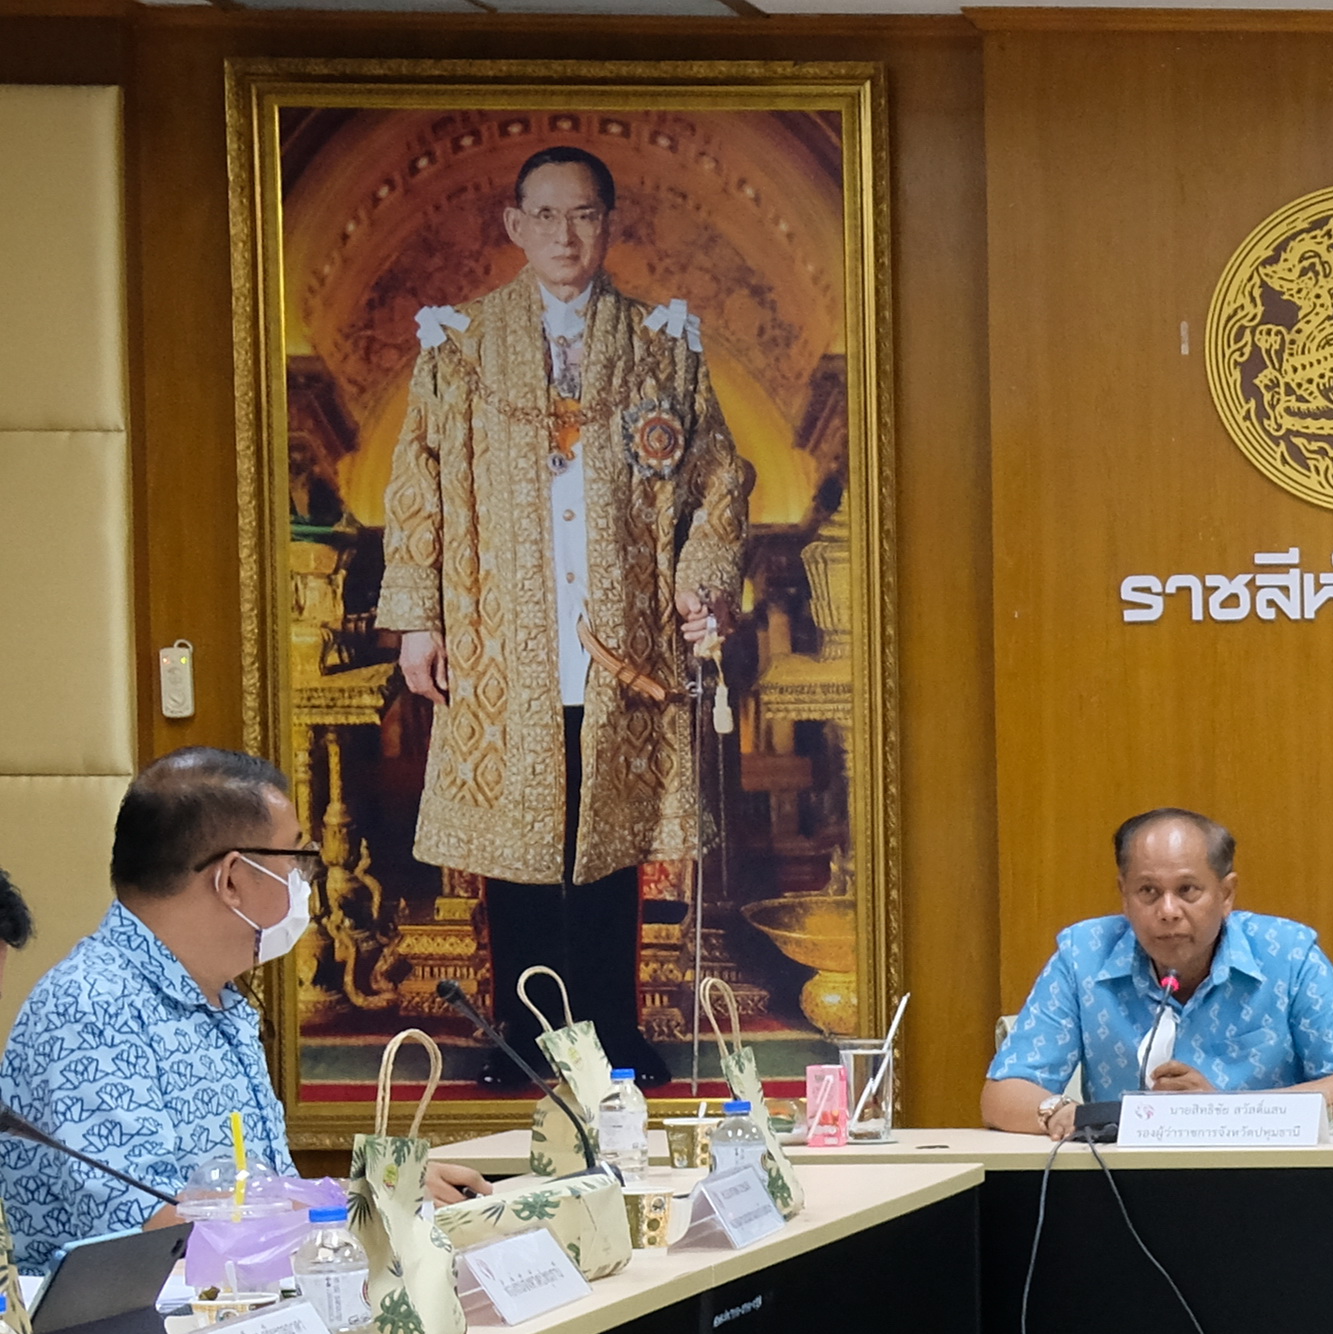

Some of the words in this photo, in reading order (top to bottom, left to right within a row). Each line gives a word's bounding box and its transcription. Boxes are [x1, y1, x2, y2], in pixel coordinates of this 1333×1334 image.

[1136, 1125, 1301, 1142] รองผู้ว่าราชการจังหวัดปทุมธานี
